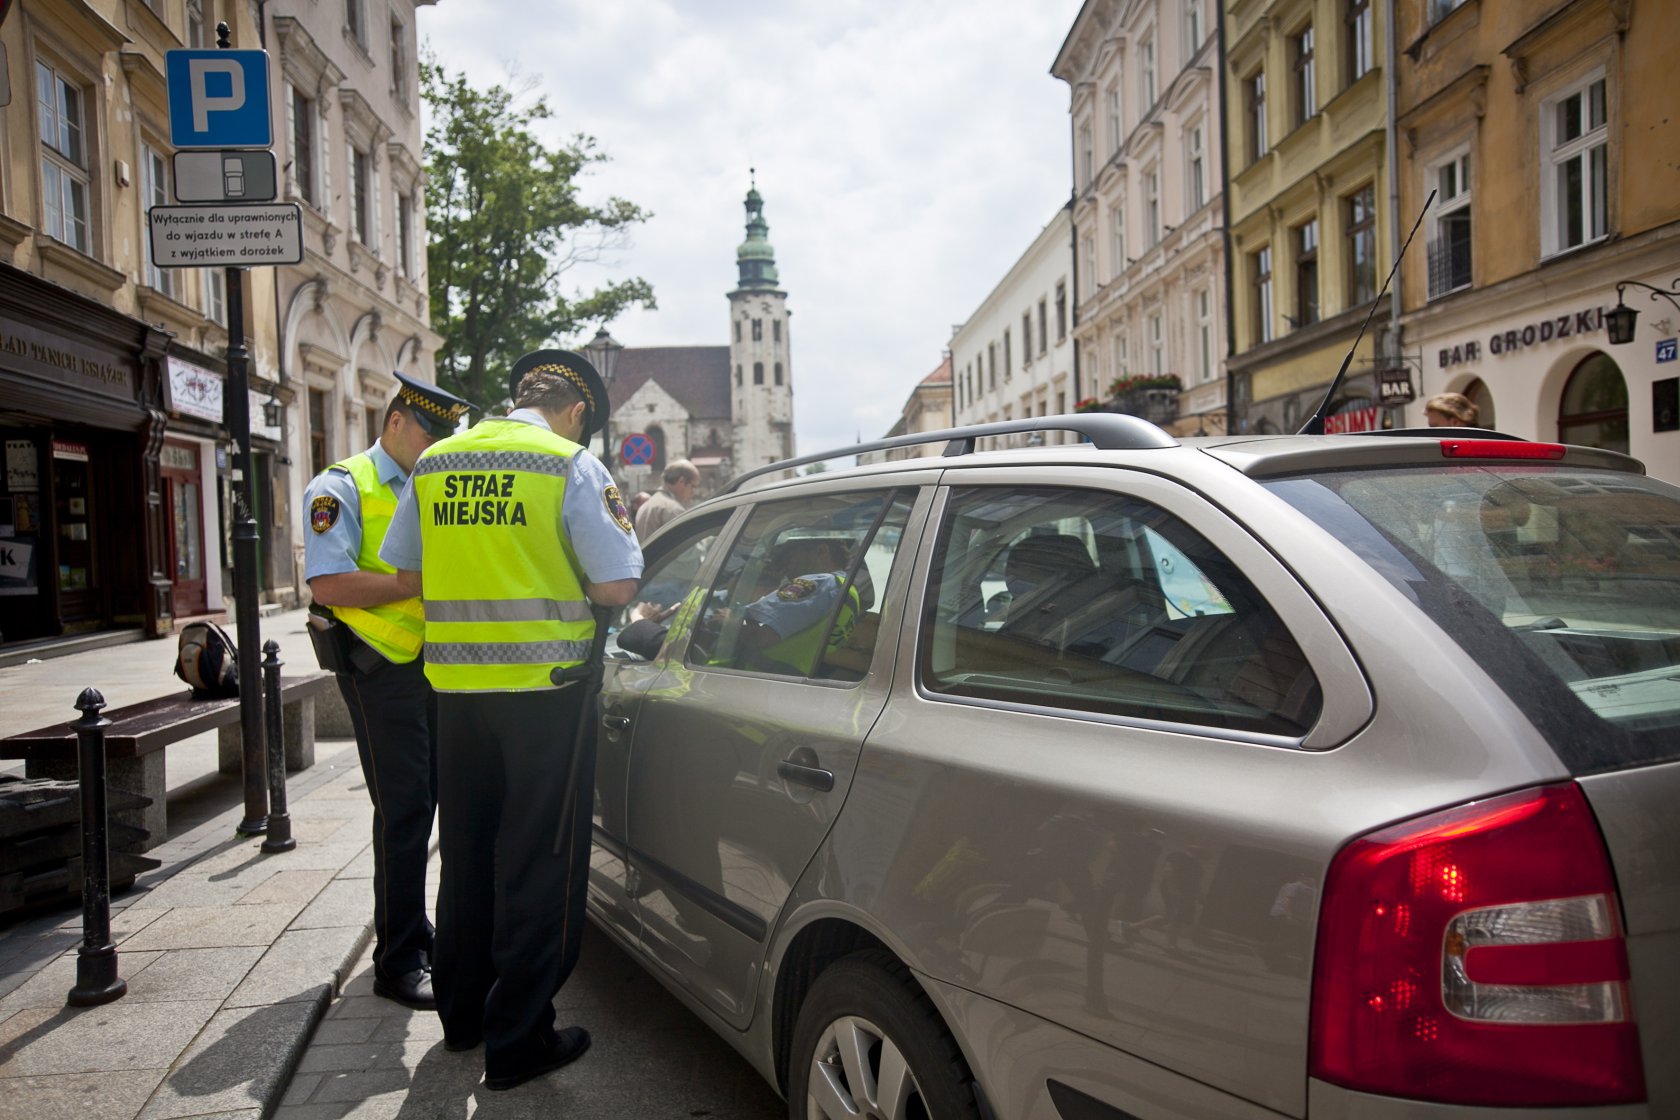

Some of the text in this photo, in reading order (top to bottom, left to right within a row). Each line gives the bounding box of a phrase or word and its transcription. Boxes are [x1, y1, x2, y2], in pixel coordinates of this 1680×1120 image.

[189, 58, 246, 133] P
[153, 212, 297, 226] Wyłącznie dla uprawnionych
[166, 231, 181, 241] do
[185, 230, 223, 242] wjazdu
[240, 229, 271, 241] strefę
[275, 229, 283, 238] A
[181, 248, 236, 260] wyjątkiem
[240, 245, 284, 256] dorożek
[1439, 307, 1604, 368] BAR GRODZKI
[31, 342, 77, 372] TANICH
[1658, 346, 1675, 360] 47
[1382, 381, 1410, 396] BAR
[434, 500, 527, 526] MIEJSKA
